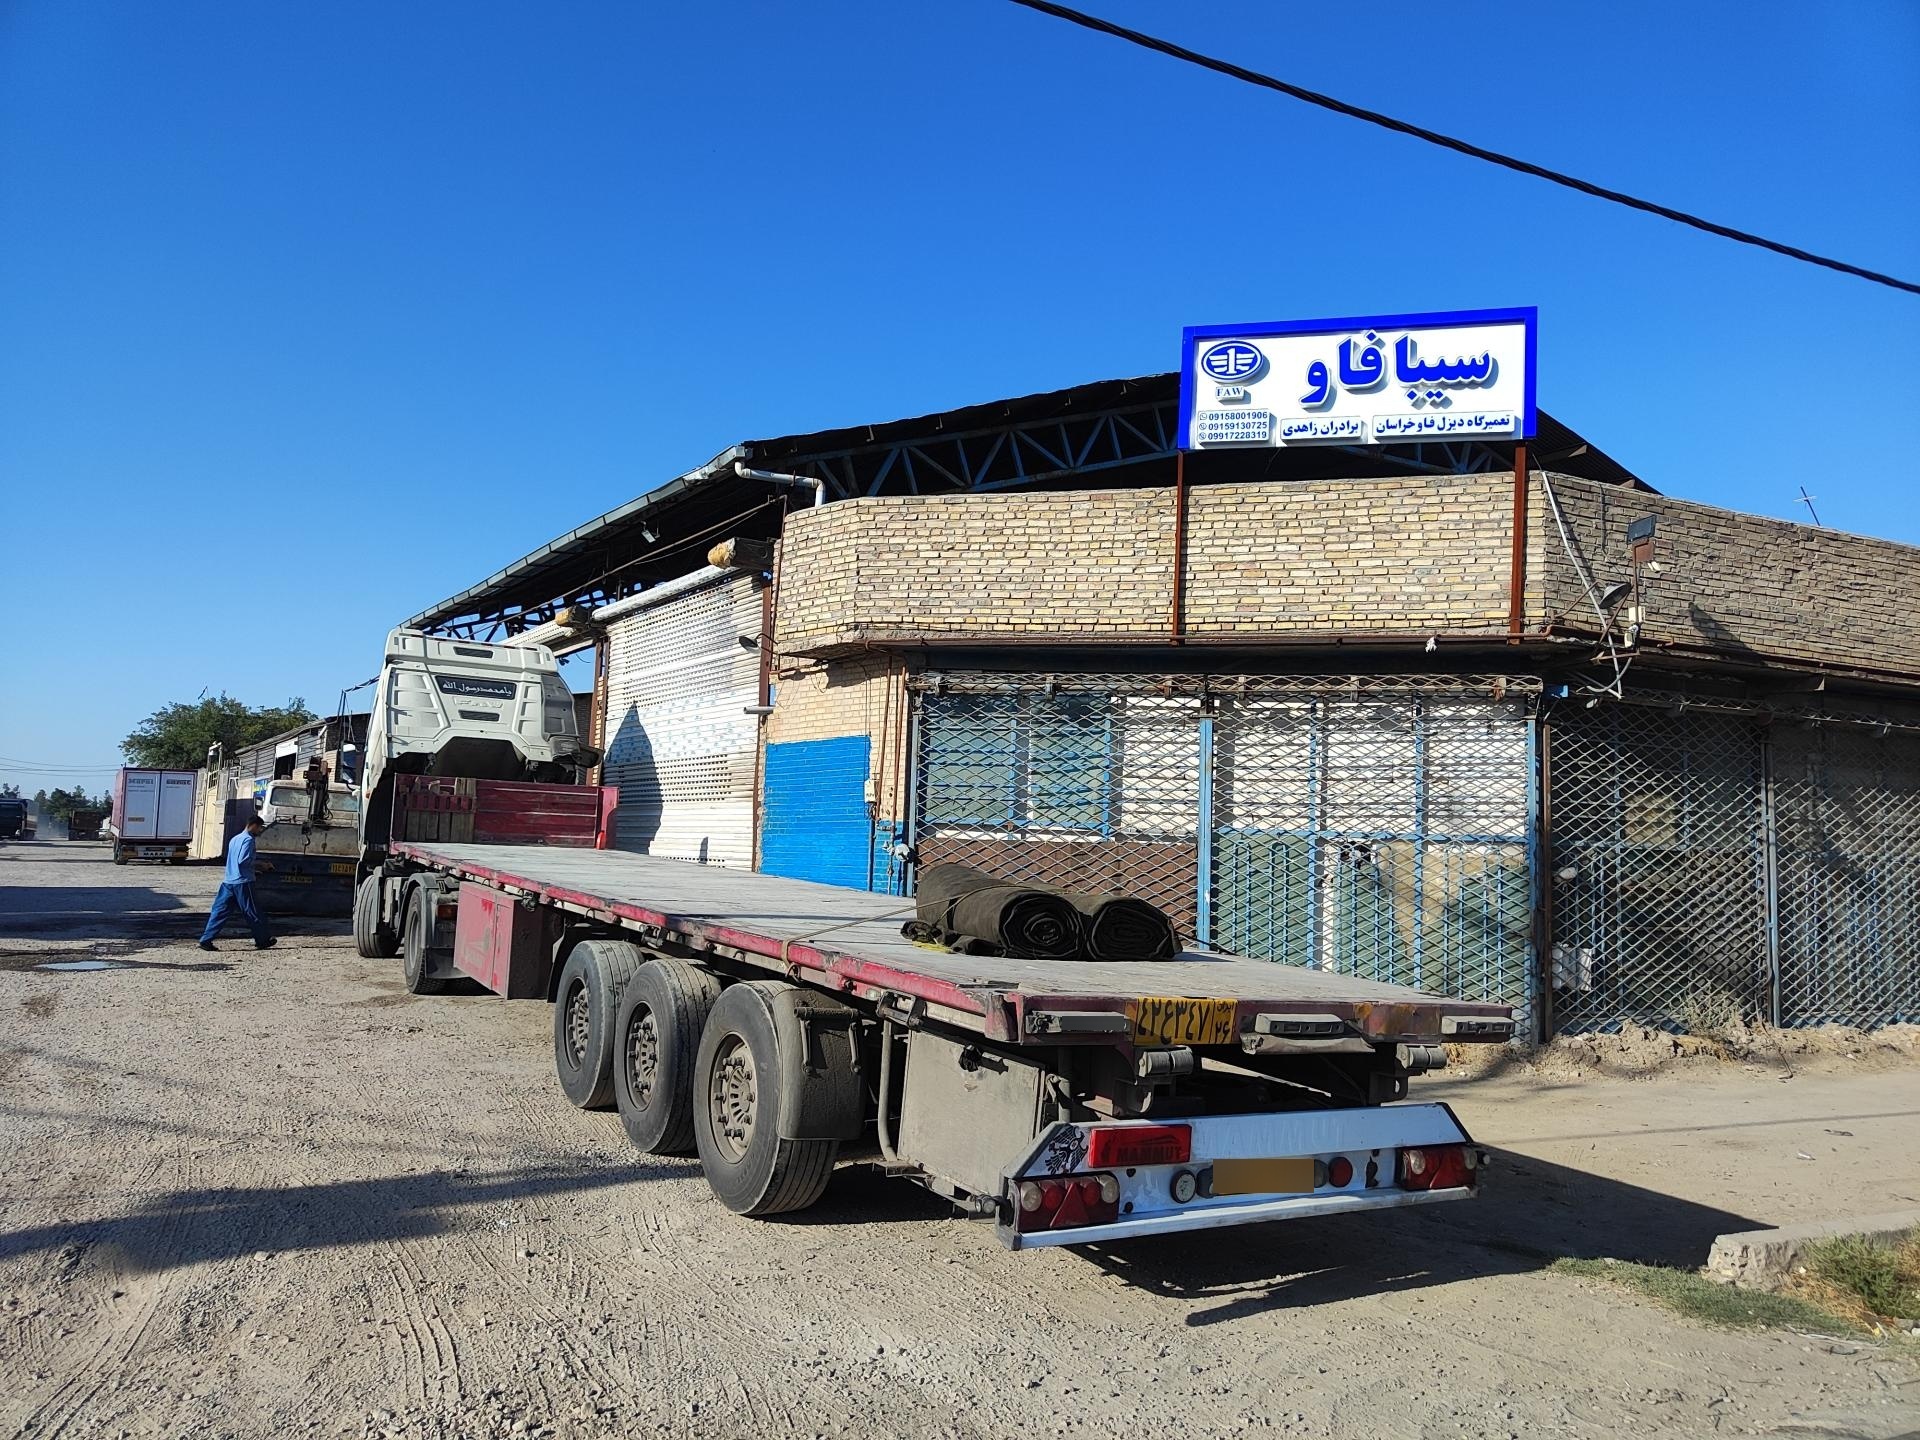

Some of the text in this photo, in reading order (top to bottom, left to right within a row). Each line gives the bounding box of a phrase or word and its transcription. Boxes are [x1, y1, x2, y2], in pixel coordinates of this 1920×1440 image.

[1300, 329, 1384, 404] فاو
[1216, 387, 1242, 397] FAW
[1208, 411, 1268, 420] 09158001906
[1375, 414, 1511, 433] تعمیرگاه دیزل فاو خراسان
[1208, 421, 1268, 430] 09159130725
[1282, 420, 1359, 436] برادران زاهدی
[1116, 1145, 1184, 1163] MAMMUT
